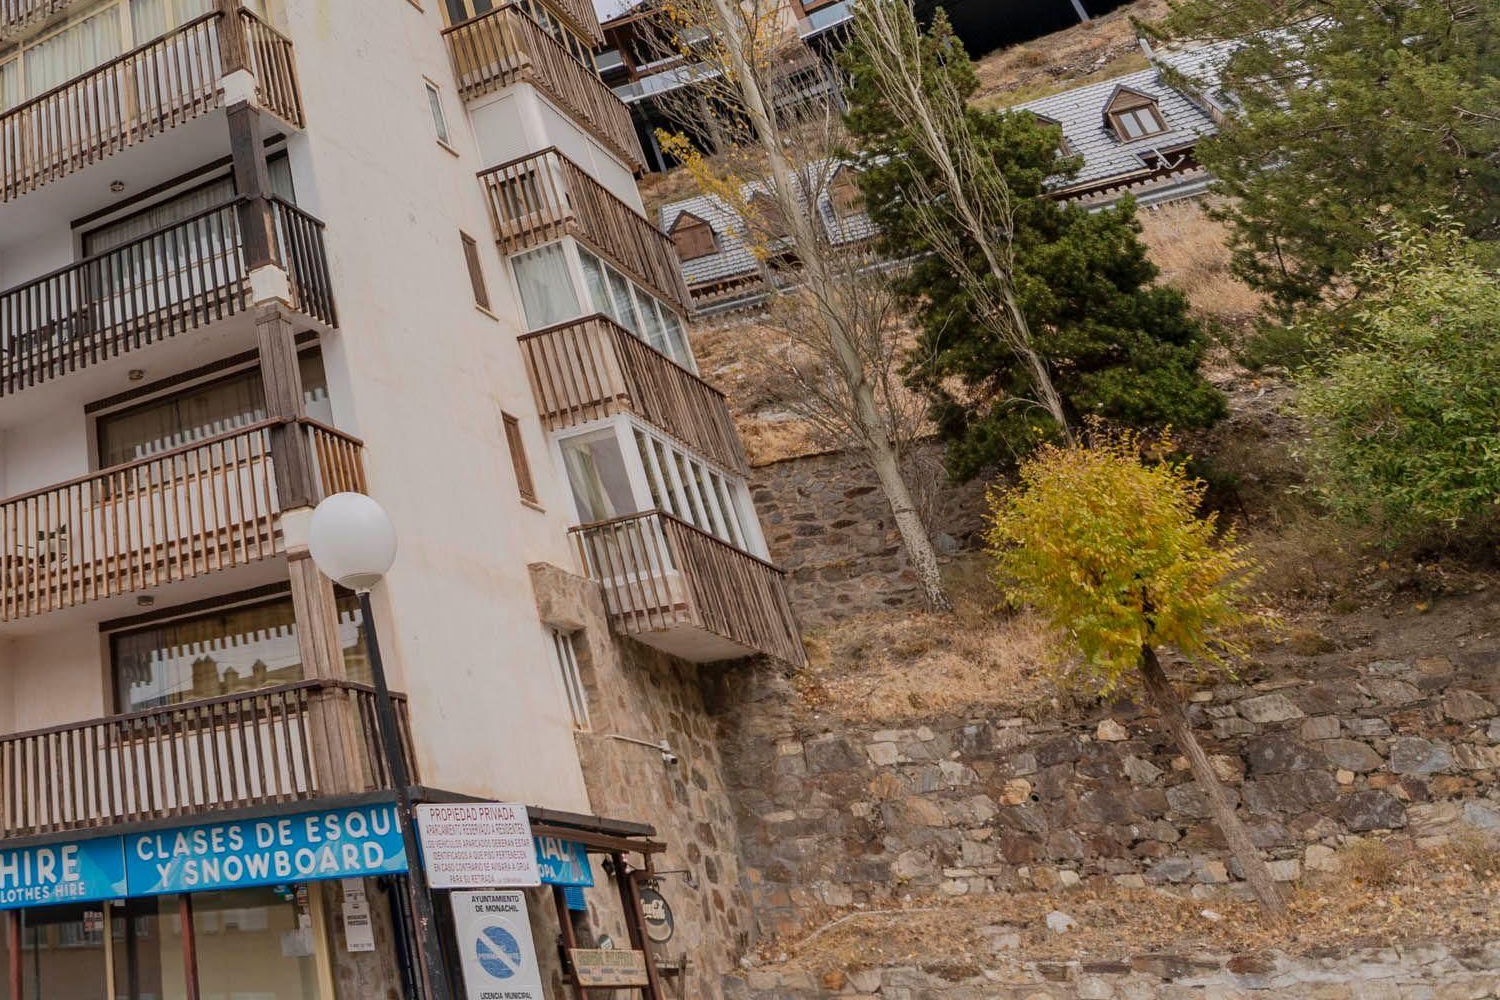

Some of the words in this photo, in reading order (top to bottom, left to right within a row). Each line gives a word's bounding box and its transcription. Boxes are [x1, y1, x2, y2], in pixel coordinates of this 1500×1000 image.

[429, 807, 477, 821] PROPIEDAD
[479, 807, 516, 821] PRIVADA
[136, 825, 244, 861] CLASES
[256, 819, 294, 849] DE
[305, 807, 402, 843] ESQUI
[156, 862, 172, 887] Y
[184, 841, 384, 886] SNOWBOARD
[55, 882, 85, 897] HIRE
[471, 895, 519, 903] AYUNTAMIENTO
[485, 904, 519, 912] MONACHIL
[480, 991, 503, 1000] LICENCIA
[504, 991, 532, 1000] MUNICIPAL
